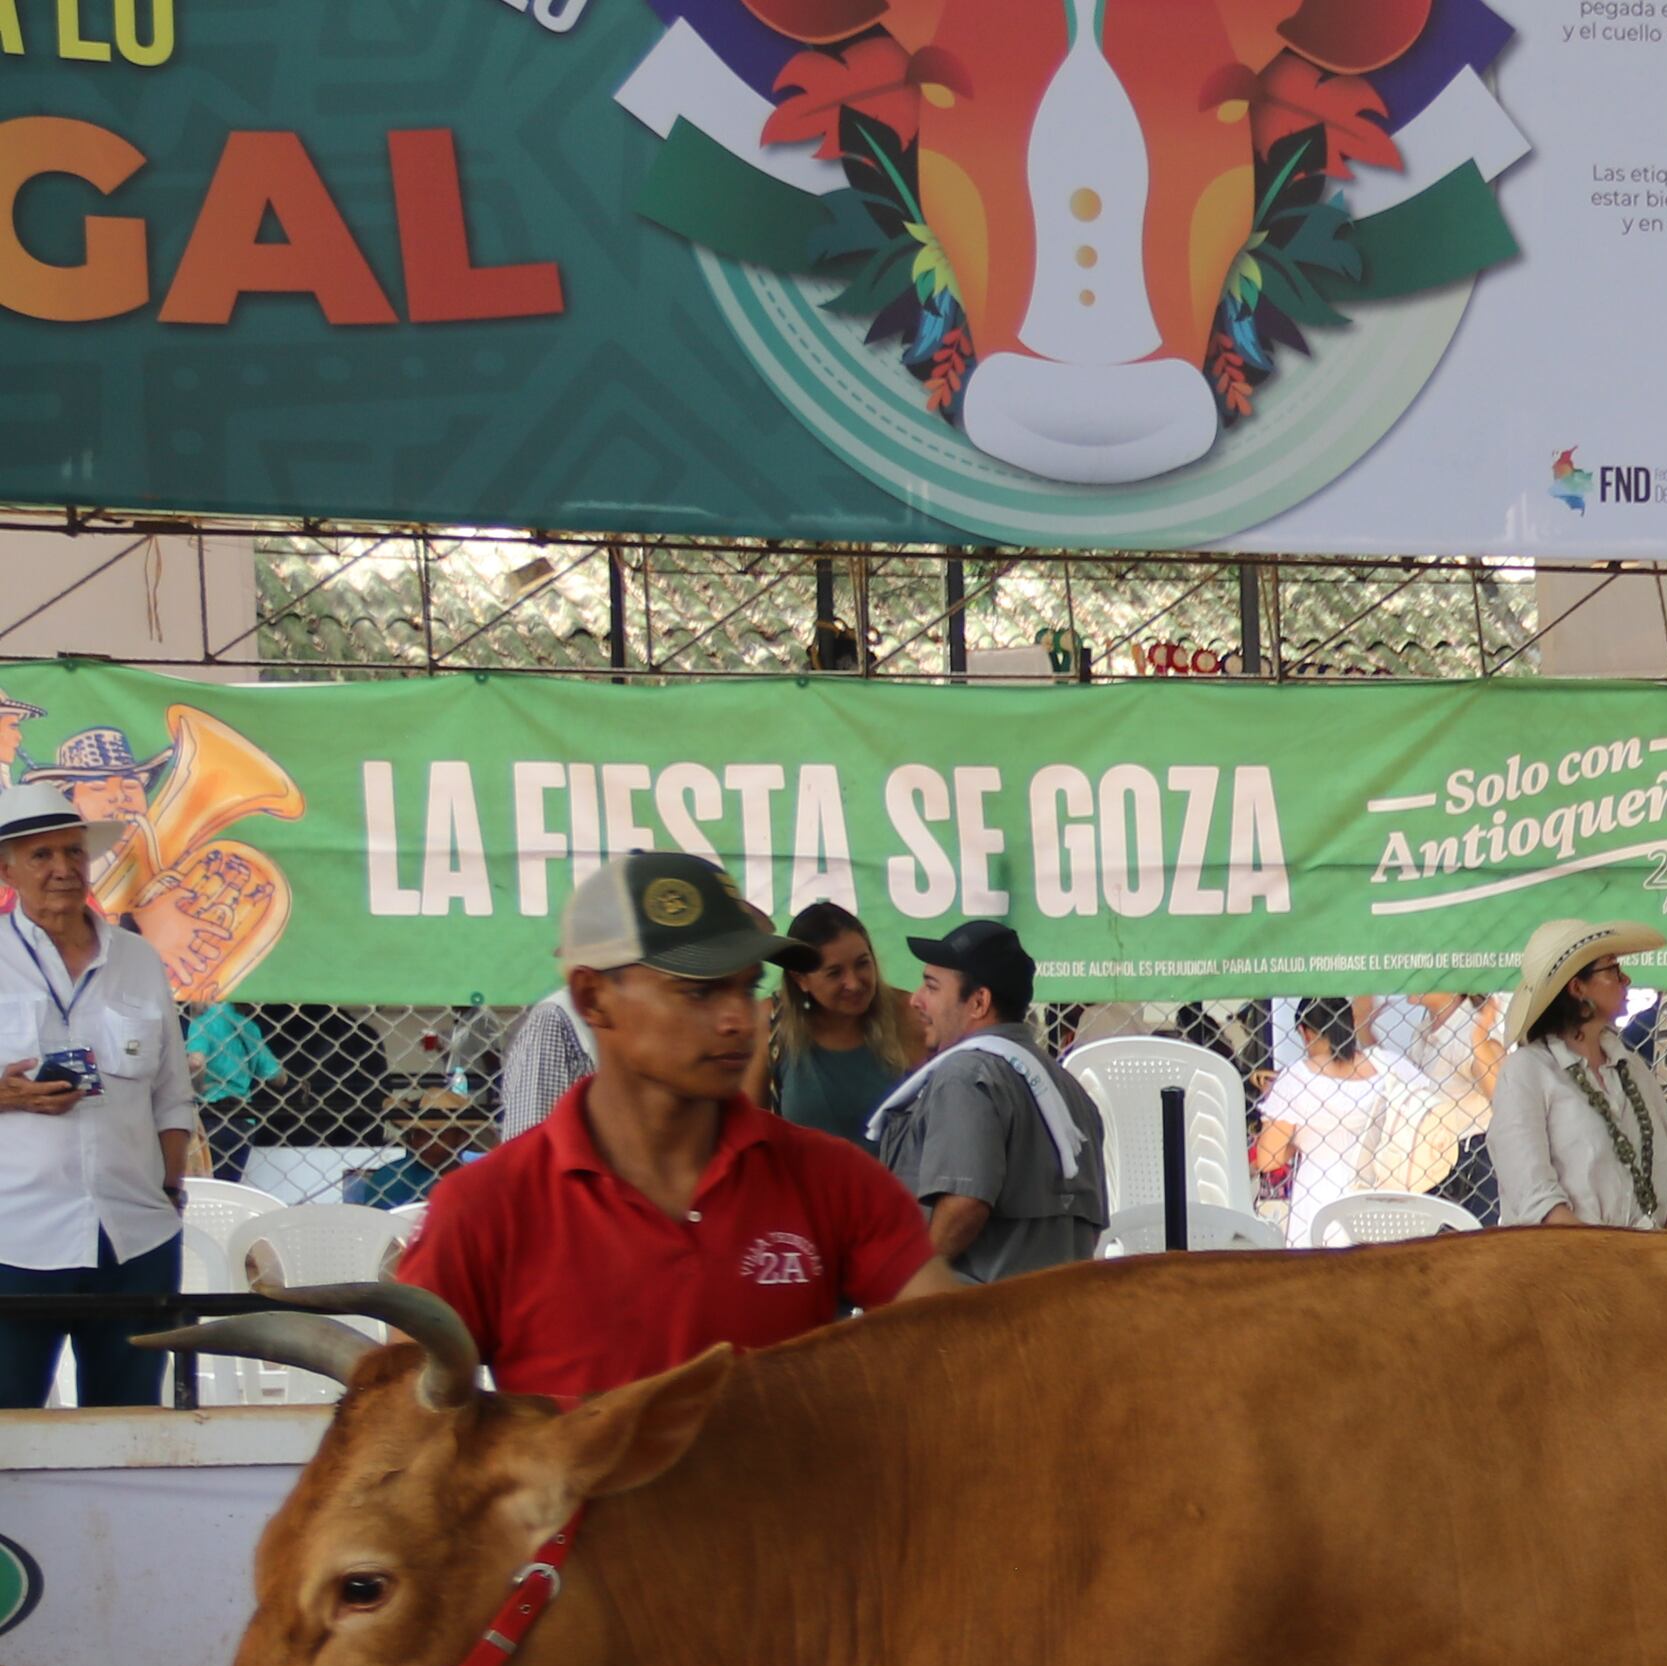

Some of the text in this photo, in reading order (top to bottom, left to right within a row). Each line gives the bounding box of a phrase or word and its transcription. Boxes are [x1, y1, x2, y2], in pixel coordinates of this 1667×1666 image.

[1580, 0, 1655, 20] pegada
[1562, 24, 1575, 43] y
[1579, 21, 1597, 40] el
[1602, 23, 1662, 42] cuello
[1592, 165, 1626, 183] Las
[1590, 191, 1640, 208] estar
[1621, 216, 1635, 236] y
[1638, 217, 1664, 233] en
[1600, 466, 1651, 504] FND
[1443, 735, 1644, 817] Solo con
[362, 760, 1292, 919] LA FIESTA SE GOZA
[1071, 961, 1087, 977] DE
[1088, 960, 1138, 978] ALCOHOL
[1139, 960, 1153, 977] ES
[1154, 959, 1221, 977] PERJUDICIAL
[1221, 958, 1252, 976] PARA
[1253, 957, 1269, 974] LA
[1269, 956, 1309, 974] SALUD.
[1309, 953, 1368, 973] PROHÍBASE
[1369, 954, 1382, 971] EL
[1383, 953, 1434, 971] EXPENDIO
[1435, 953, 1450, 970] DE
[1451, 952, 1497, 969] BEBIDAS
[1498, 951, 1524, 969] EMB
[1640, 951, 1655, 967] DE
[757, 1251, 810, 1285] 2A
